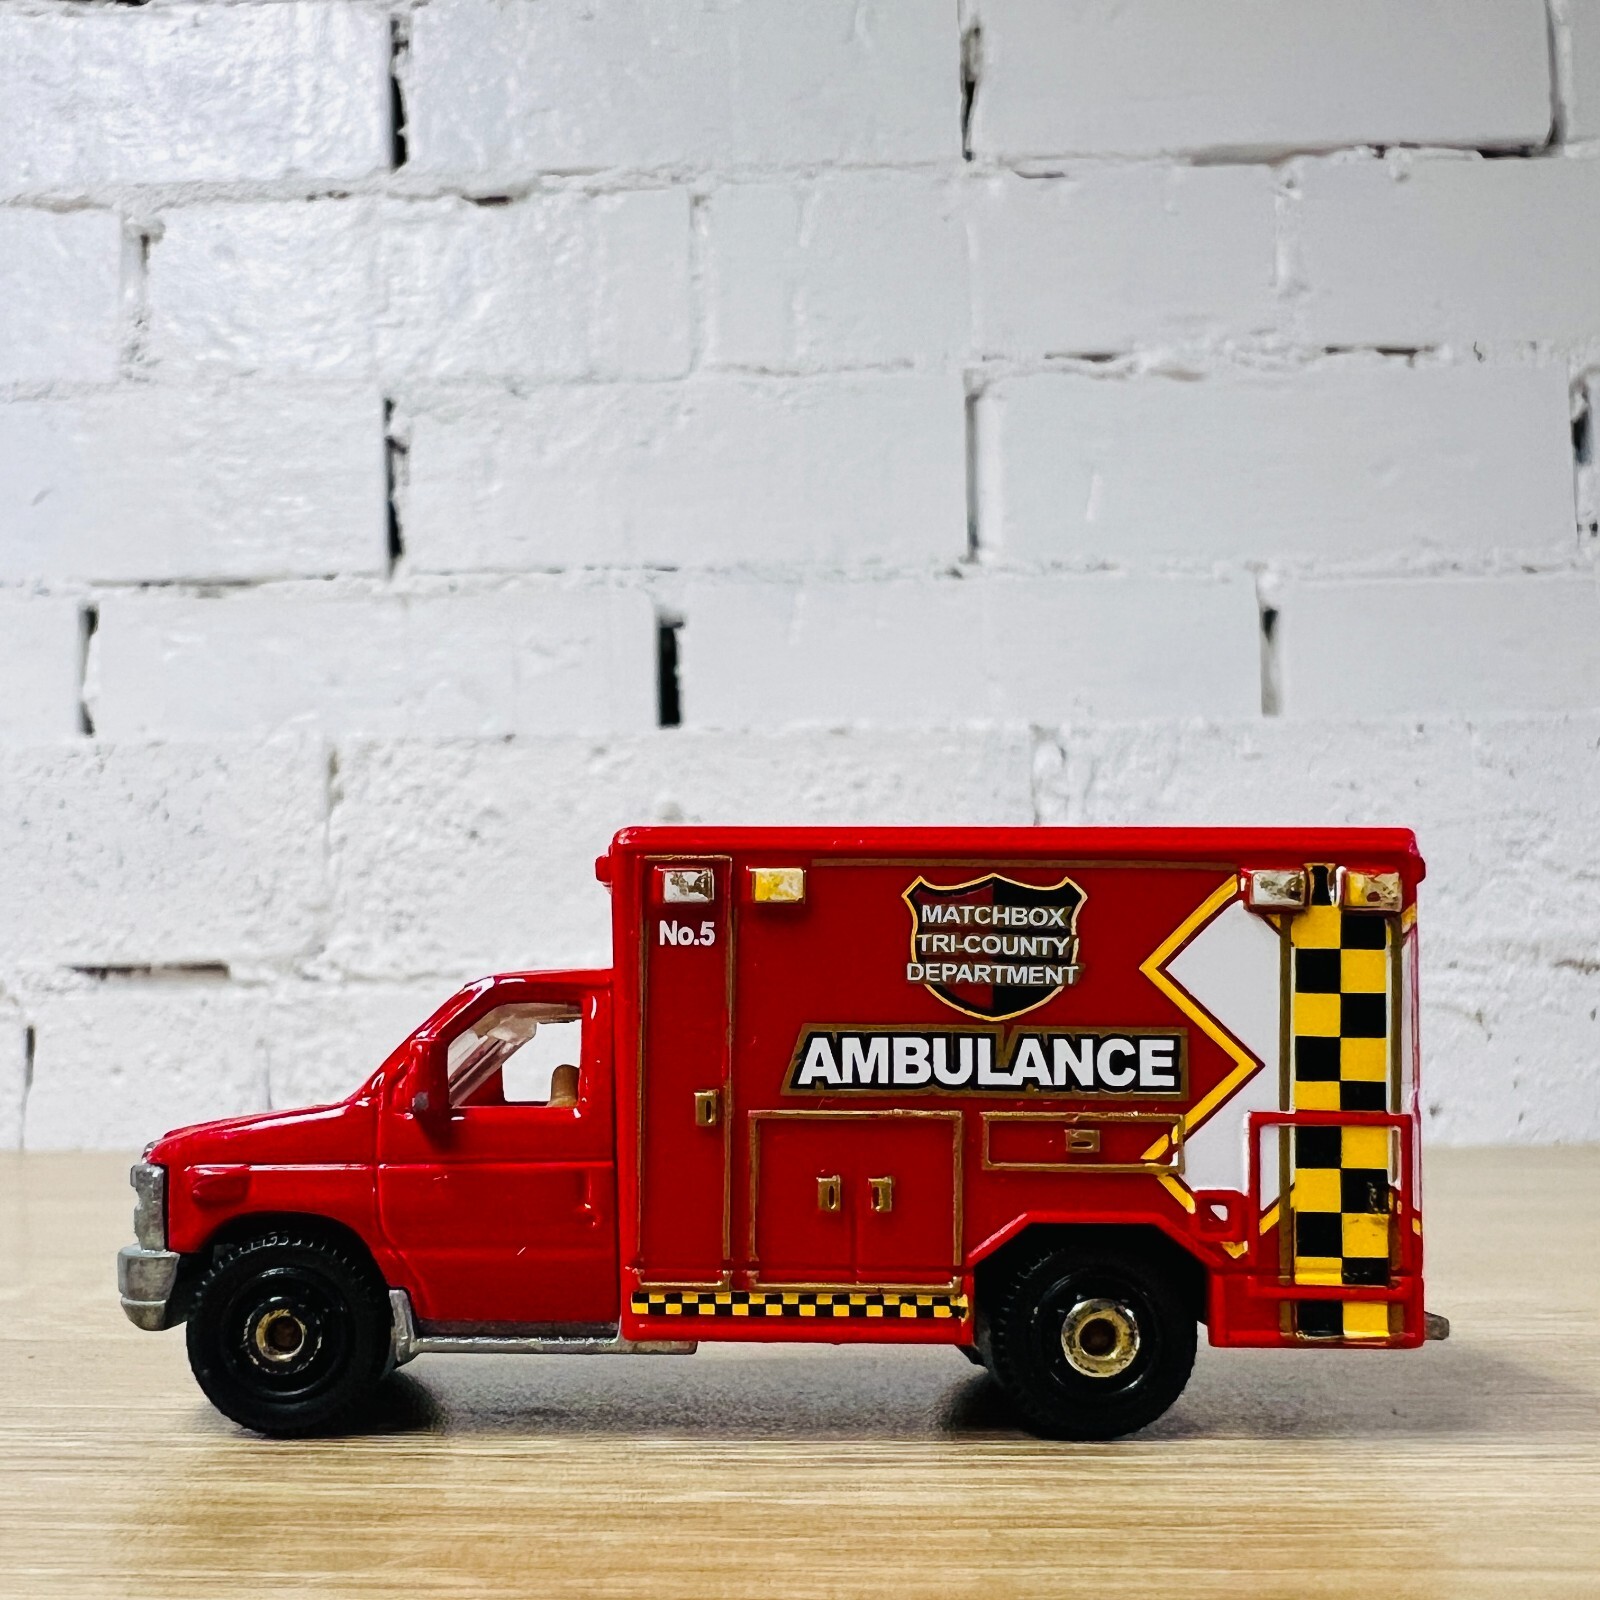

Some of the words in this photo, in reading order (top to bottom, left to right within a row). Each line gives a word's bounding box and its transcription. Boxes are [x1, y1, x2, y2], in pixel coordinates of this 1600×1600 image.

[921, 905, 1066, 927] MATCHBOX
[659, 920, 715, 946] No.5
[916, 934, 1070, 956] TRI-COUNTY
[906, 962, 1079, 985] DEPARTMENT
[798, 1037, 1175, 1087] AMBULANCE
